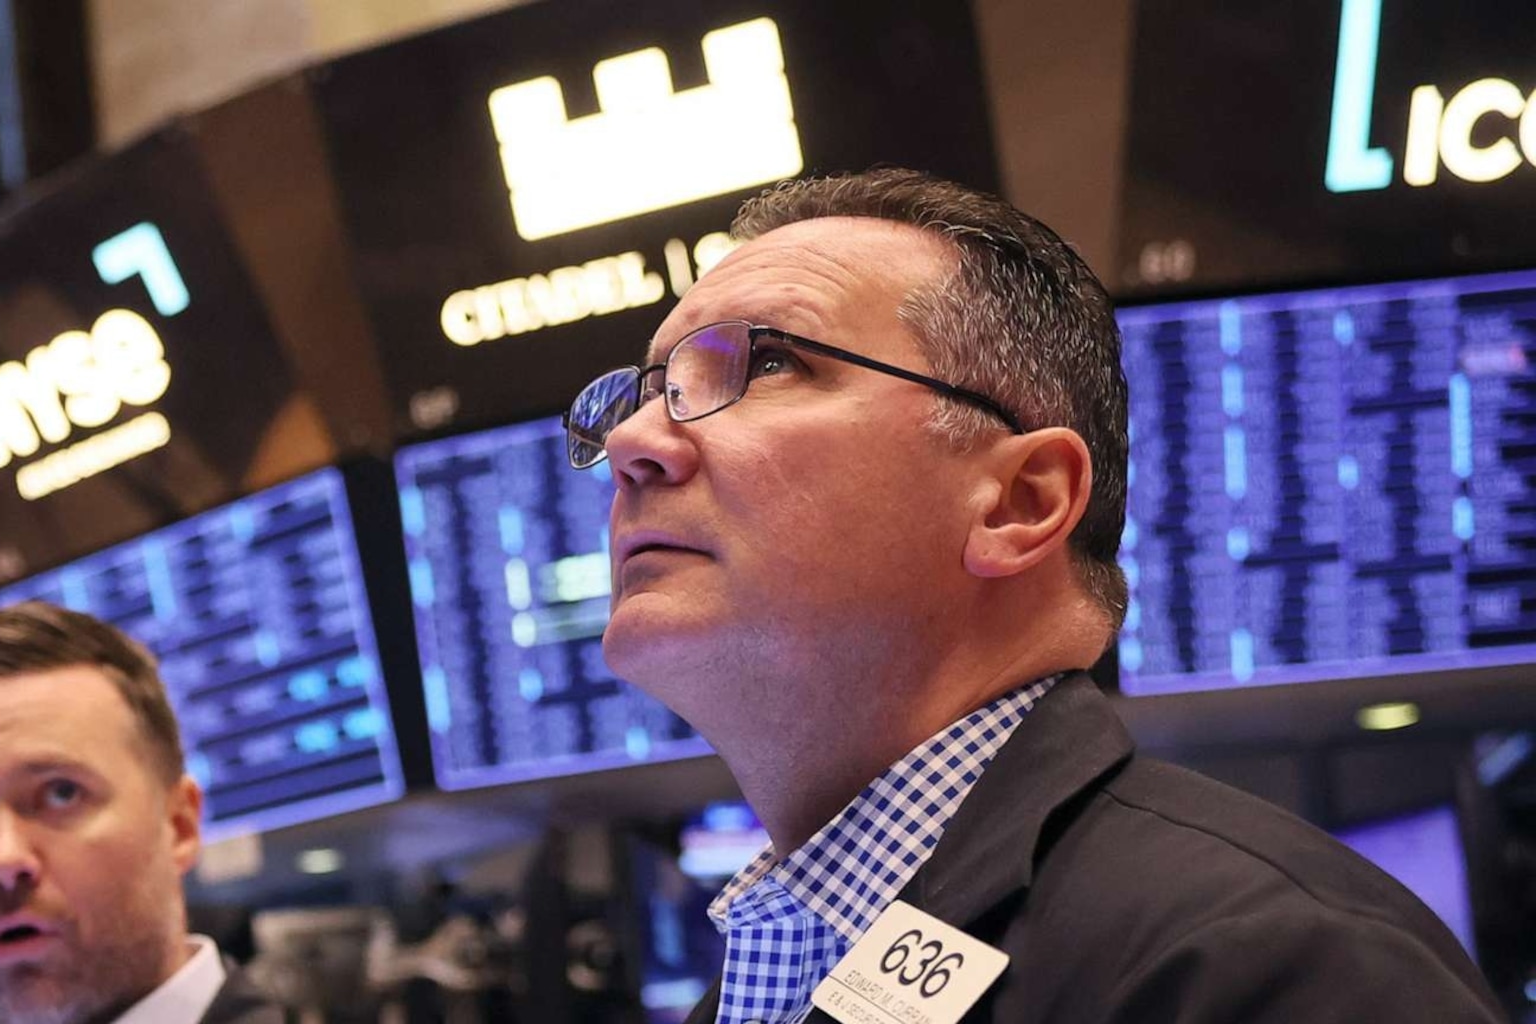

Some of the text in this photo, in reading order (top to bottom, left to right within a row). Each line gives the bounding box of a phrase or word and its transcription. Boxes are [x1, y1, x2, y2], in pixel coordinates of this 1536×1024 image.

[1404, 78, 1536, 187] IC
[843, 969, 884, 1001] EDWARD
[879, 928, 965, 999] 636
